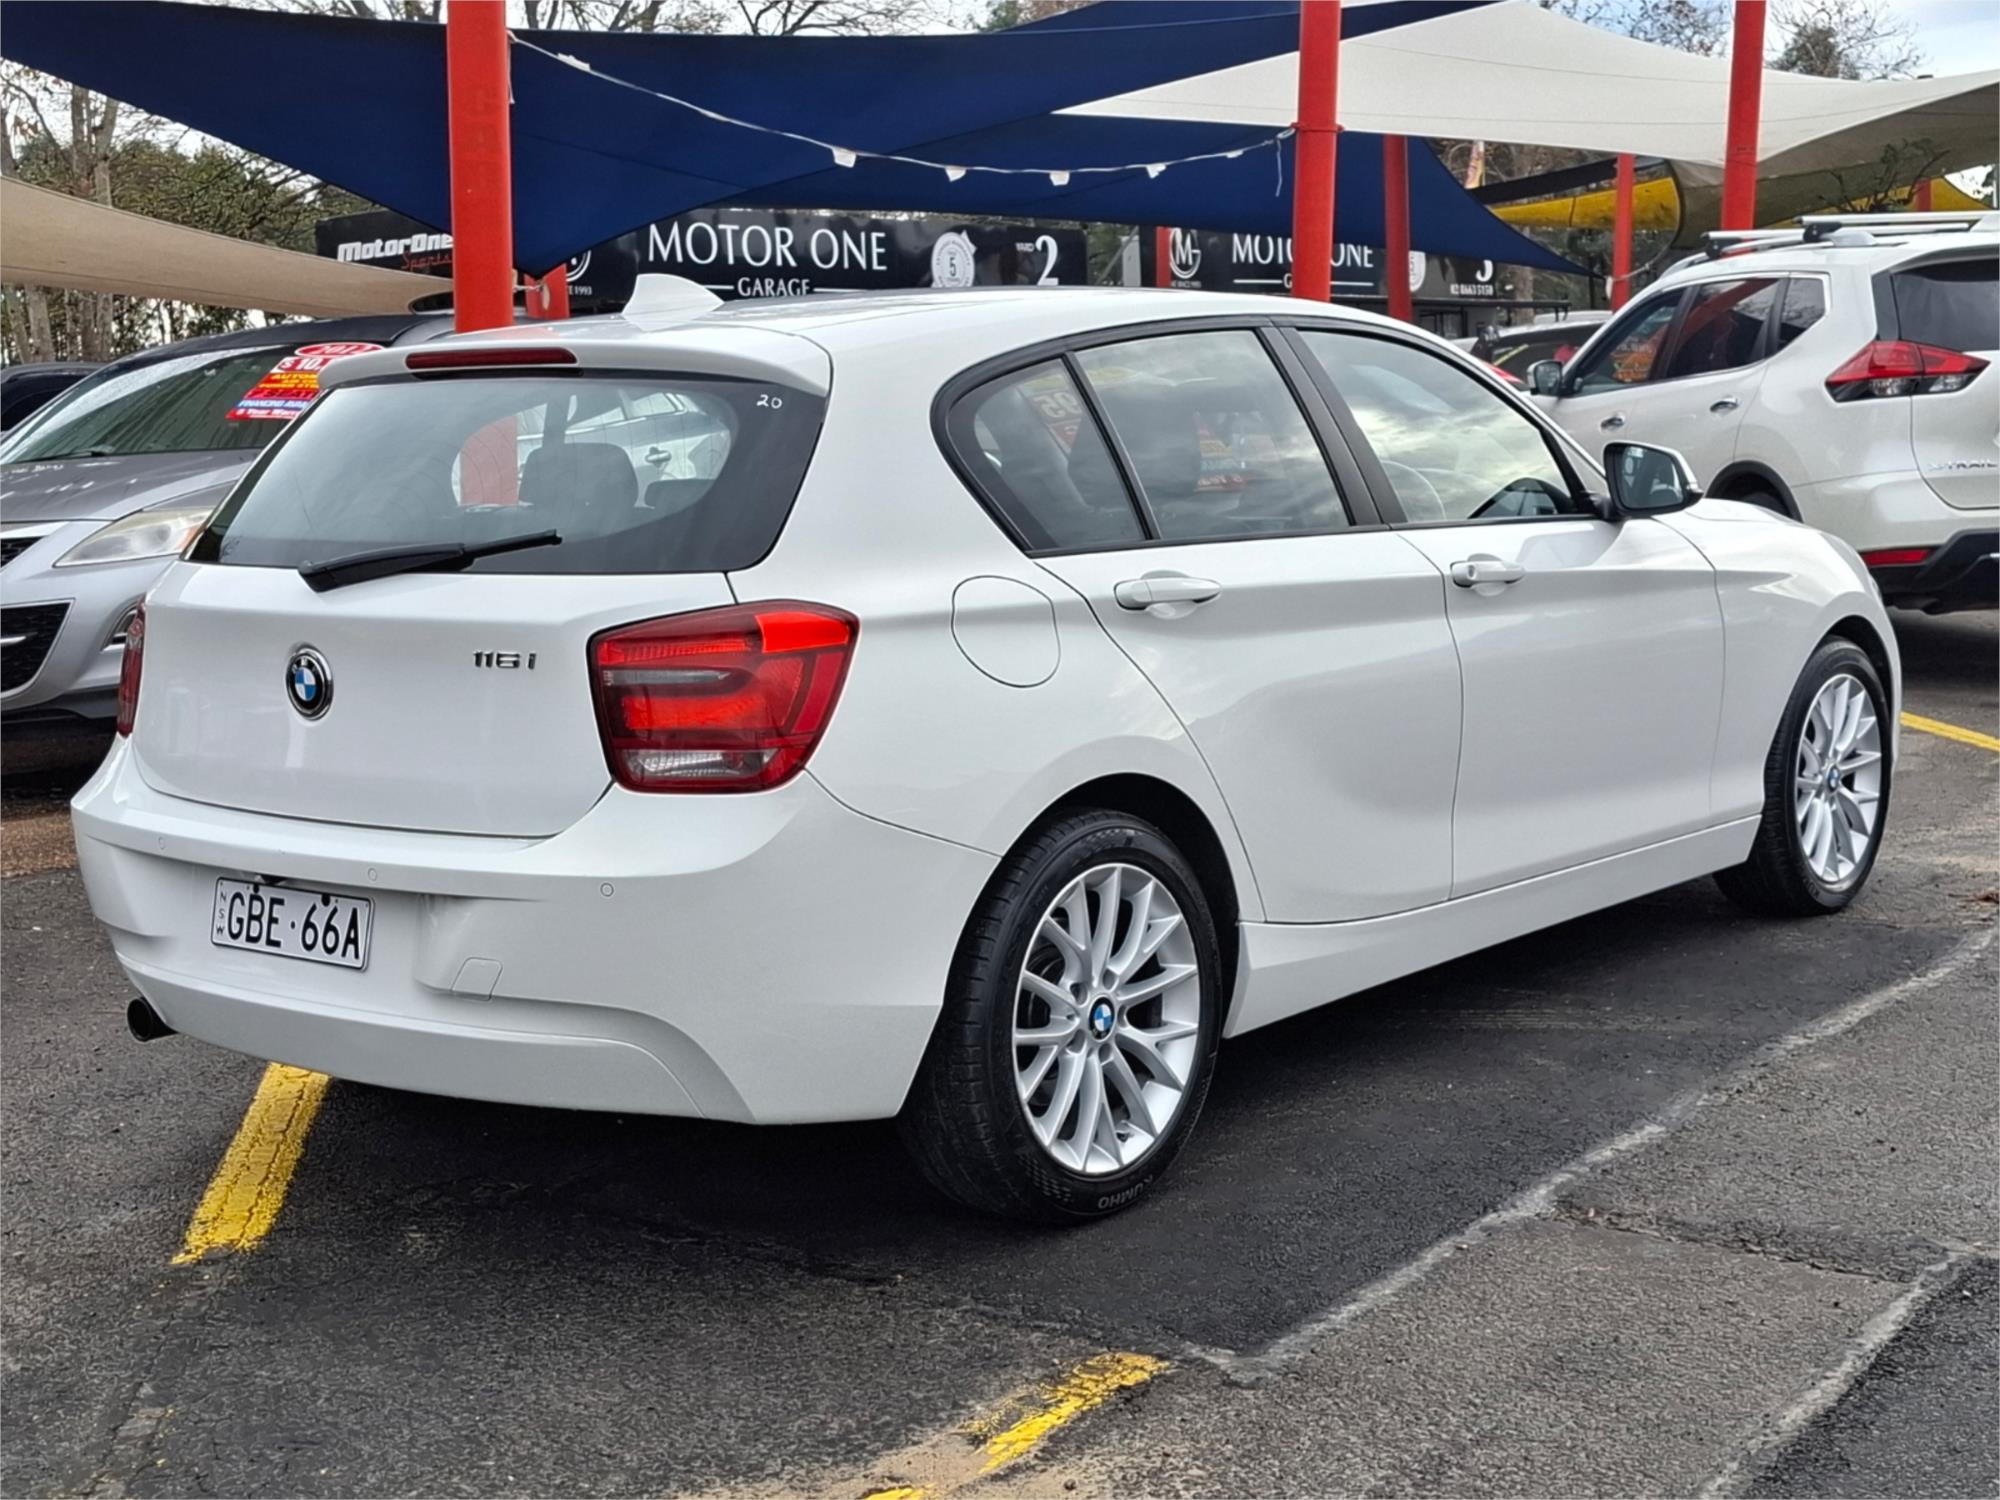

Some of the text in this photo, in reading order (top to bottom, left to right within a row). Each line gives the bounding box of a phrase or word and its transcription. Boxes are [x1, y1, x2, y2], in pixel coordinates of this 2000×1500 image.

[648, 220, 888, 271] MOTOR ONE
[1035, 235, 1060, 286] 2
[737, 277, 810, 297] GARAGE
[757, 394, 783, 409] 20
